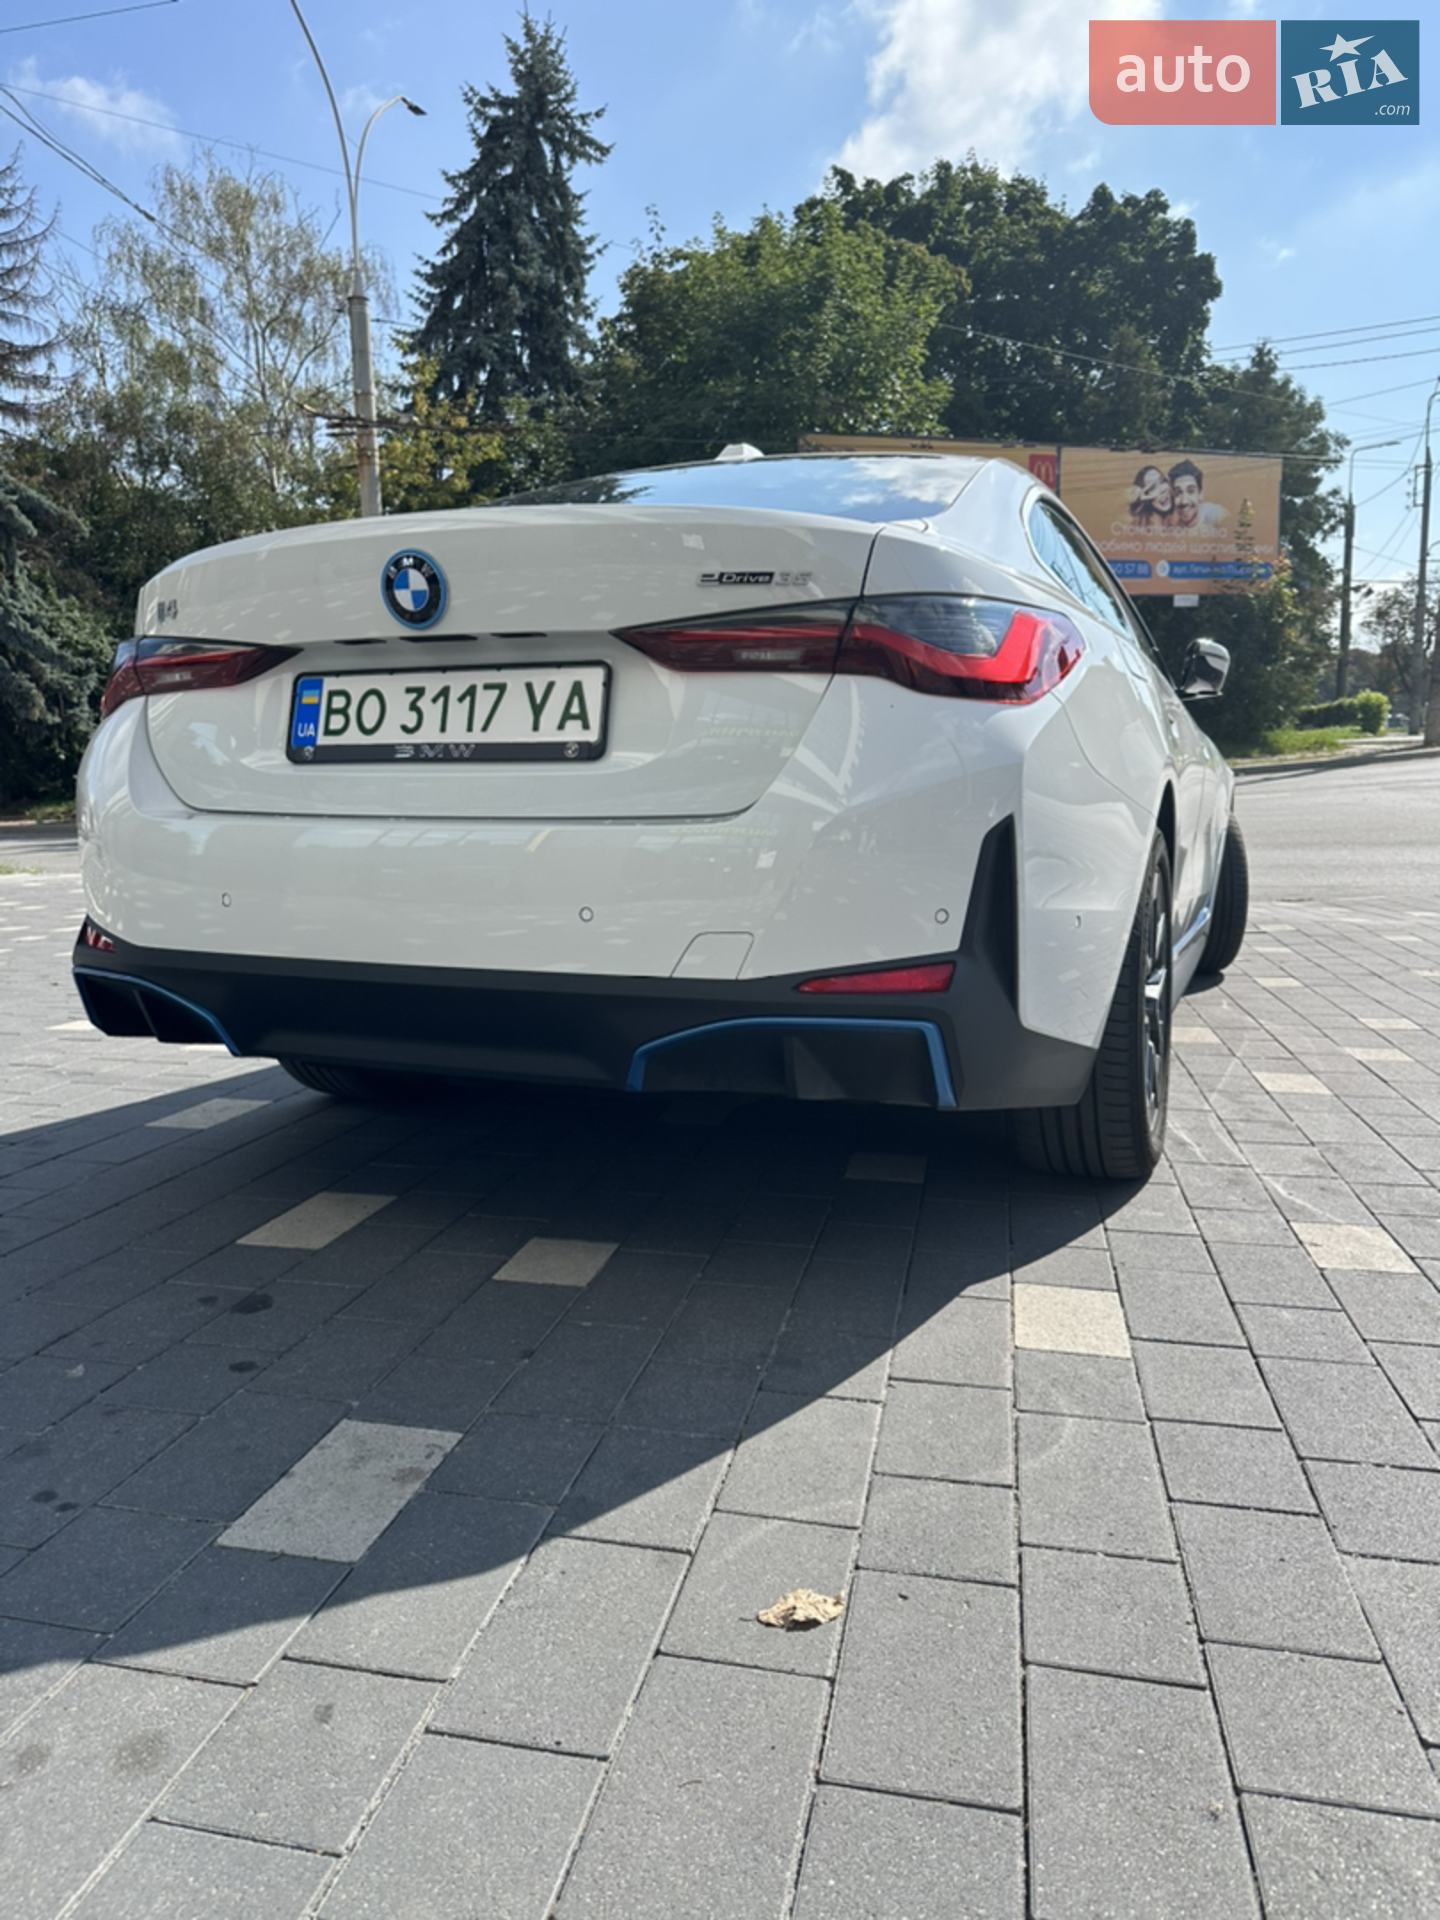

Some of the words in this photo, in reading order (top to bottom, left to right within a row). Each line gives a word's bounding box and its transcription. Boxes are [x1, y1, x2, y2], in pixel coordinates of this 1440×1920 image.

[323, 688, 387, 737] BO
[400, 682, 508, 735] 3117
[525, 680, 592, 732] YA
[297, 722, 316, 738] UA
